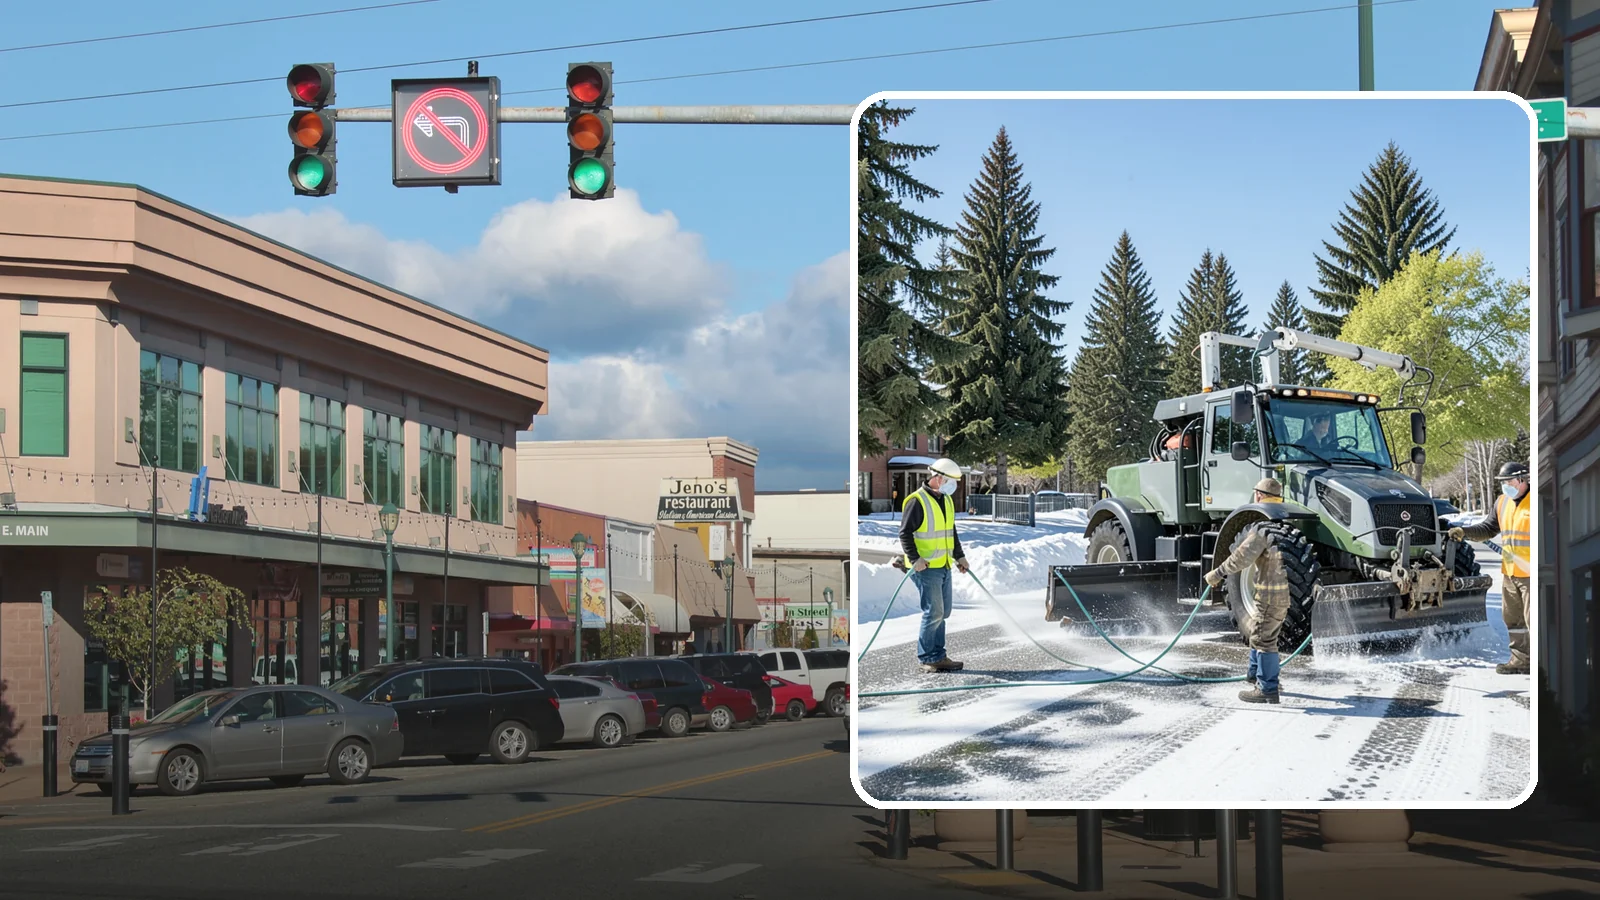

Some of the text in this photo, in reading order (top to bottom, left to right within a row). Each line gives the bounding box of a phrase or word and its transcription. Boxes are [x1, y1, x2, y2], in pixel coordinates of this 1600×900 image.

[670, 480, 727, 494] Jeno's
[665, 496, 731, 509] restaurant
[659, 510, 681, 519] Italian
[686, 510, 714, 519] American
[715, 509, 737, 519] Cuisine
[2, 525, 49, 536] E. MAIN
[797, 607, 829, 617] Street
